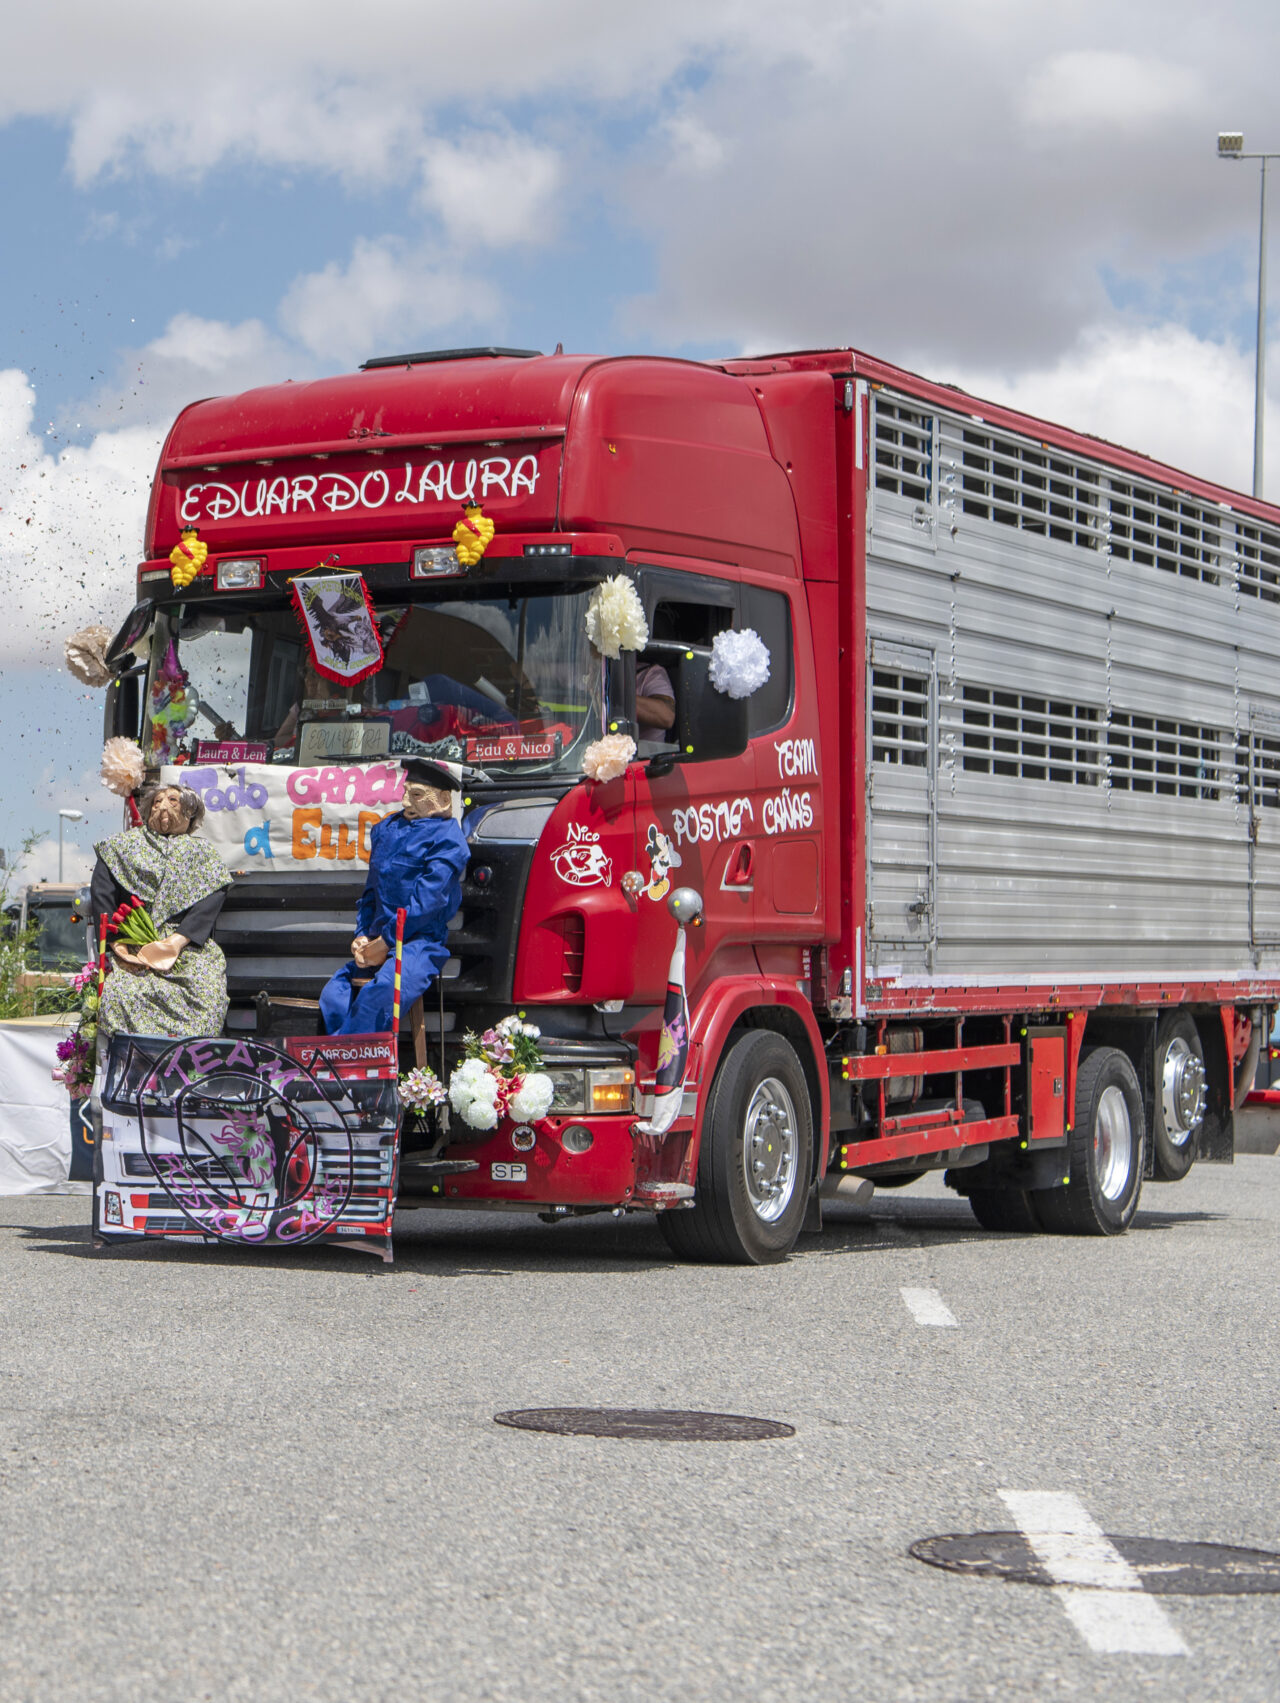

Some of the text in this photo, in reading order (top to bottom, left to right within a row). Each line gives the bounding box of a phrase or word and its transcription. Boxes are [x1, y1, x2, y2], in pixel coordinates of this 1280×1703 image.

[180, 454, 540, 521] EDUARDO LAURA
[198, 745, 229, 759] Laura
[231, 746, 240, 759] &
[476, 741, 551, 757] Edu & Nico
[774, 738, 818, 779] TEAM
[179, 766, 269, 812] Todo
[762, 787, 814, 835] CAÑAS
[292, 808, 400, 864] ELLO
[566, 822, 600, 842] Nico
[164, 1040, 299, 1091] TEAM
[359, 1046, 391, 1059] LAURA
[494, 1164, 523, 1179] SP
